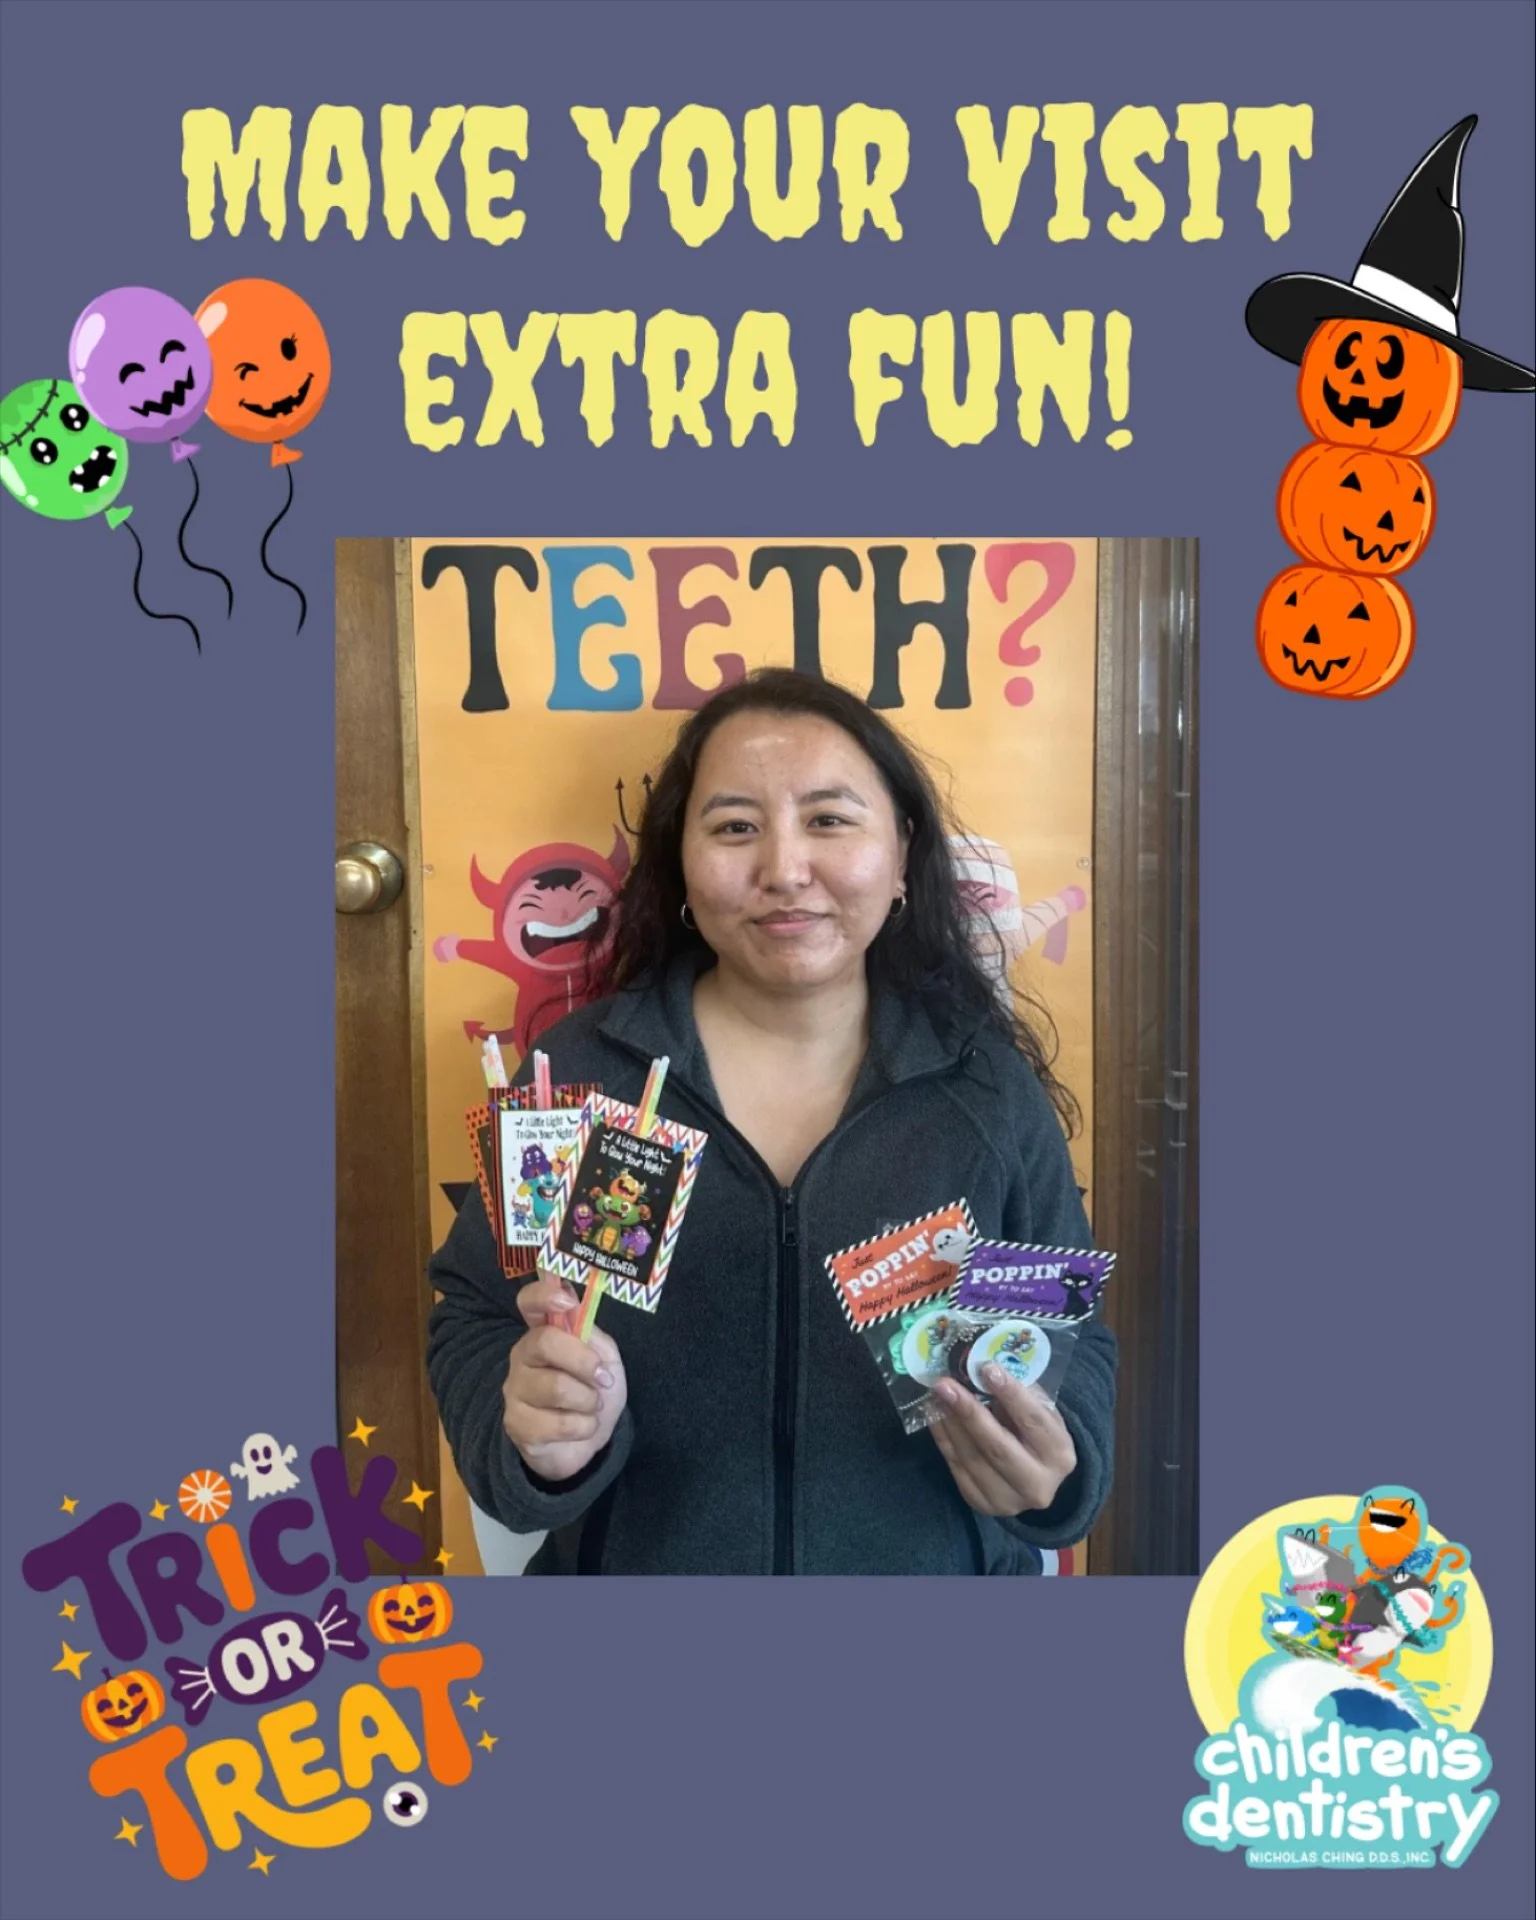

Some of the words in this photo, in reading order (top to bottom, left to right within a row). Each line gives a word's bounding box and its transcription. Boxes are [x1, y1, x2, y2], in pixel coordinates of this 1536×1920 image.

[421, 542, 1077, 712] TEETH?
[624, 1151, 644, 1168] Your
[640, 1143, 661, 1160] Light
[515, 1229, 539, 1242] HAPPY
[572, 1242, 596, 1262] HAPPY
[594, 1253, 639, 1278] HALLOWEEN
[845, 1229, 930, 1299] POPPIN'
[851, 1252, 874, 1270] Just
[969, 1262, 1070, 1285] POPPIN'
[859, 1294, 894, 1313] Happy
[895, 1264, 953, 1298] Halloween!
